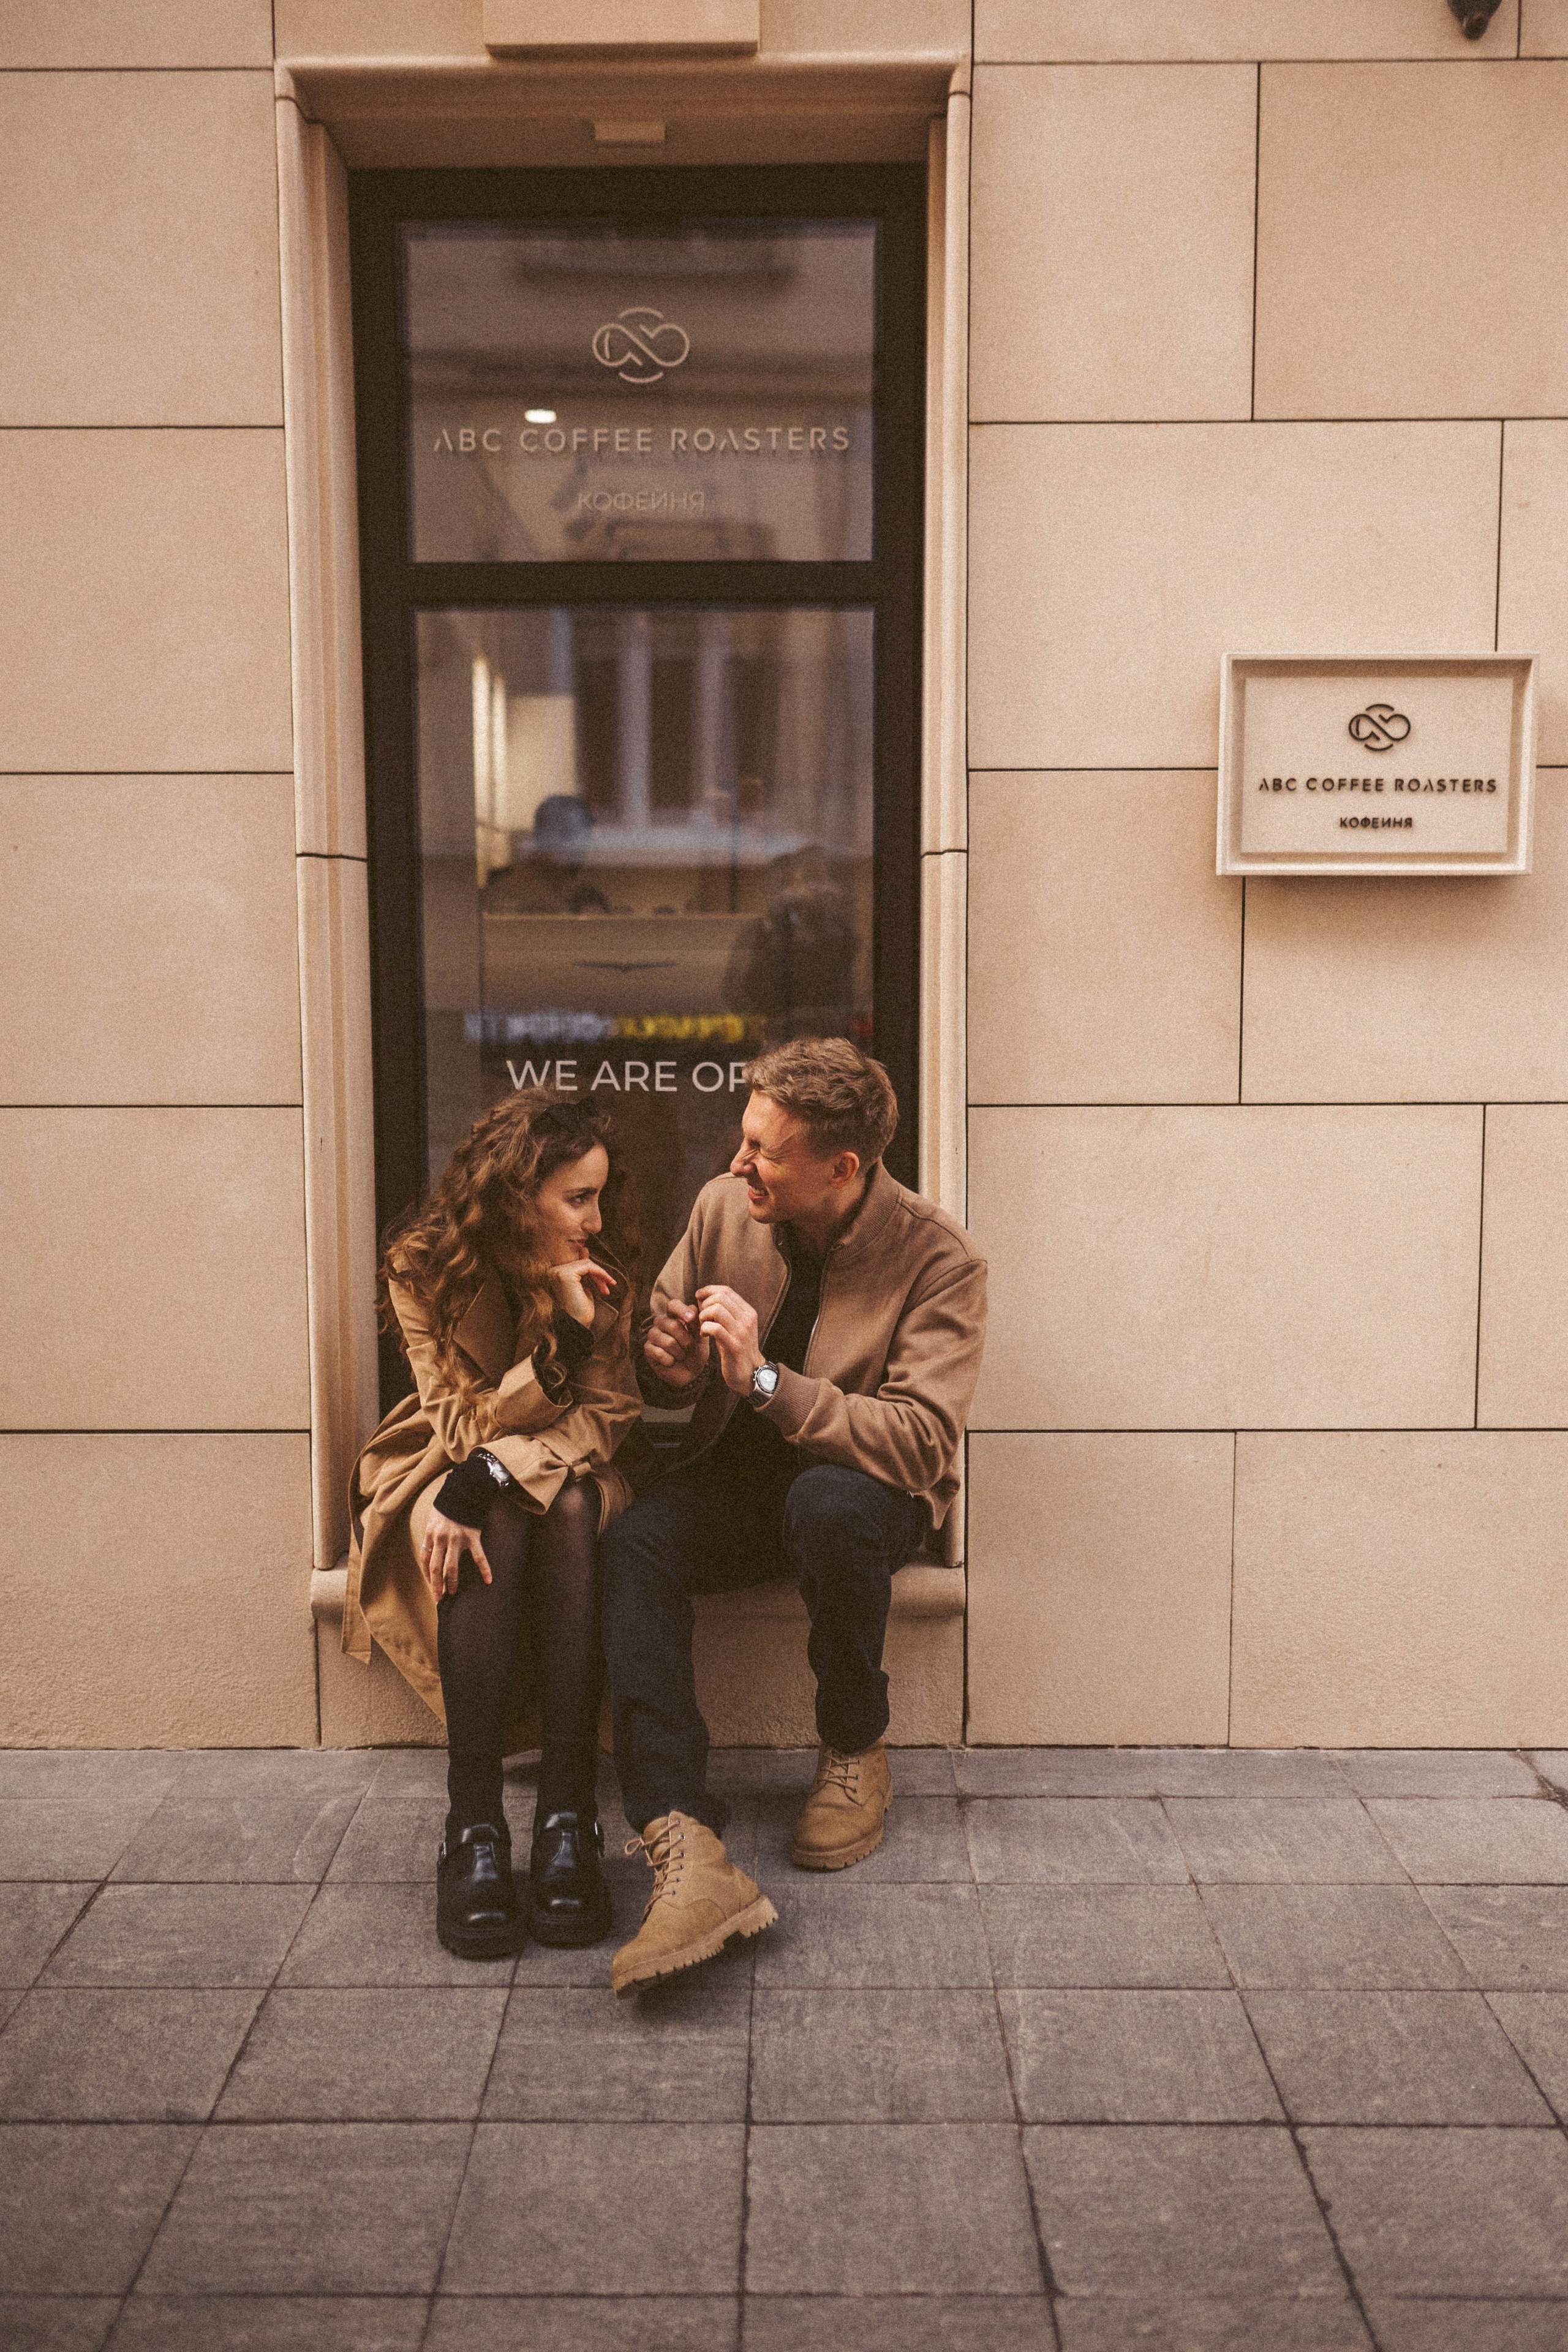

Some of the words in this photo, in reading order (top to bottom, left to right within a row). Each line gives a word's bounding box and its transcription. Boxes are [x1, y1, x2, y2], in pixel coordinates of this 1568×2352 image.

[434, 428, 501, 451] ABC
[520, 428, 652, 452] COFFEE
[671, 427, 850, 451] ROASTERS
[1259, 777, 1297, 792] ABC
[1306, 777, 1384, 793] COFFEE
[1394, 778, 1497, 793] ROASTERS
[506, 1060, 578, 1091] WE
[590, 1061, 677, 1091] ARE
[692, 1061, 747, 1093] OP
